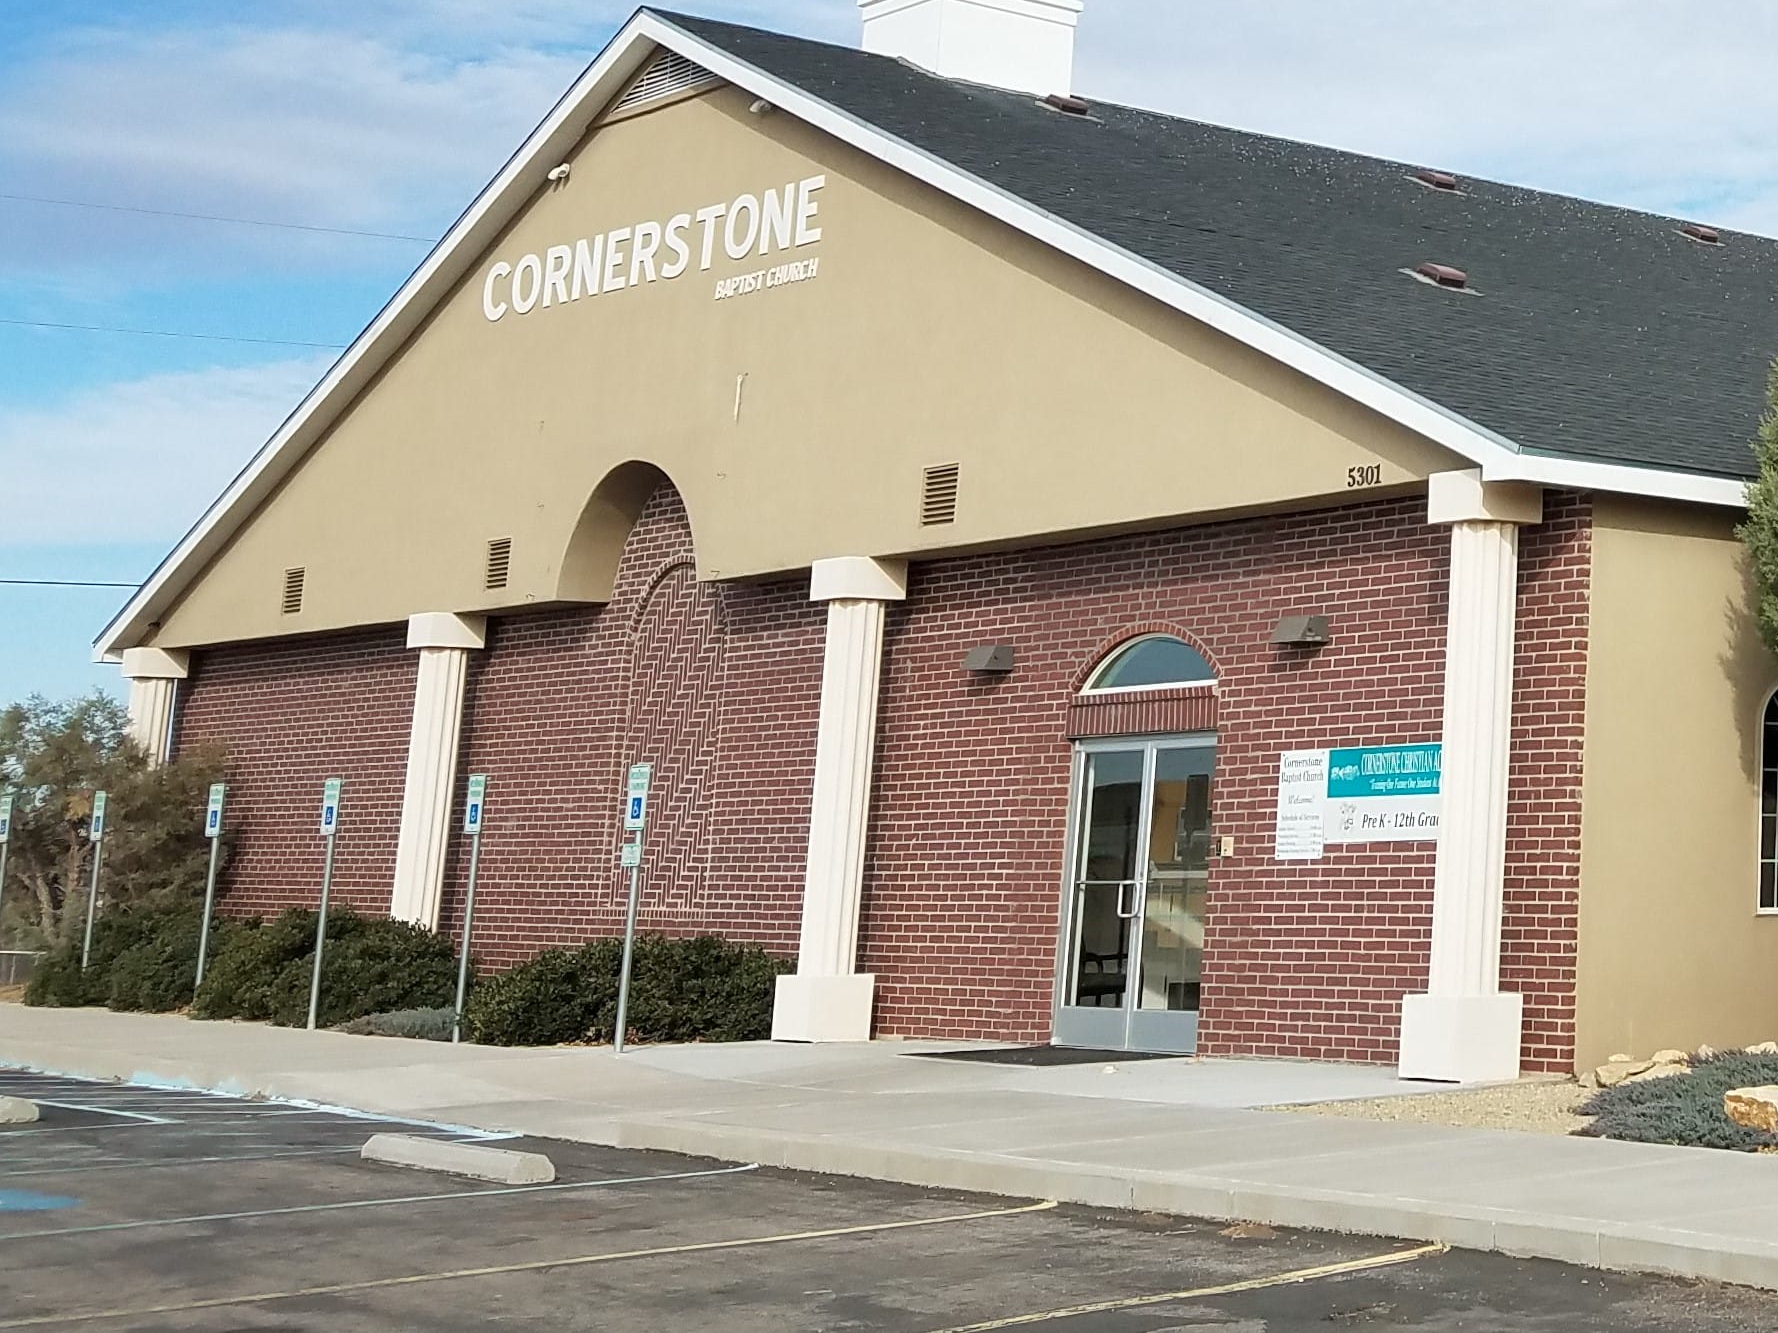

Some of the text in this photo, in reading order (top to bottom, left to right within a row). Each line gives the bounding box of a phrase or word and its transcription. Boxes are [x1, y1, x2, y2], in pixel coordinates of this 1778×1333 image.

[482, 174, 826, 322] CORNERSTONE
[714, 257, 819, 301] BAPTIST CHURCH
[1347, 463, 1382, 487] 5301
[1283, 758, 1323, 769] Cornerstone
[1361, 752, 1401, 776] CORNERSTONE
[1401, 750, 1433, 774] CHRISTIAN
[1281, 771, 1302, 784] Baptist
[1302, 770, 1324, 782] Church
[1361, 813, 1378, 829] Pre
[1379, 813, 1387, 828] K
[1394, 811, 1415, 828] 12th
